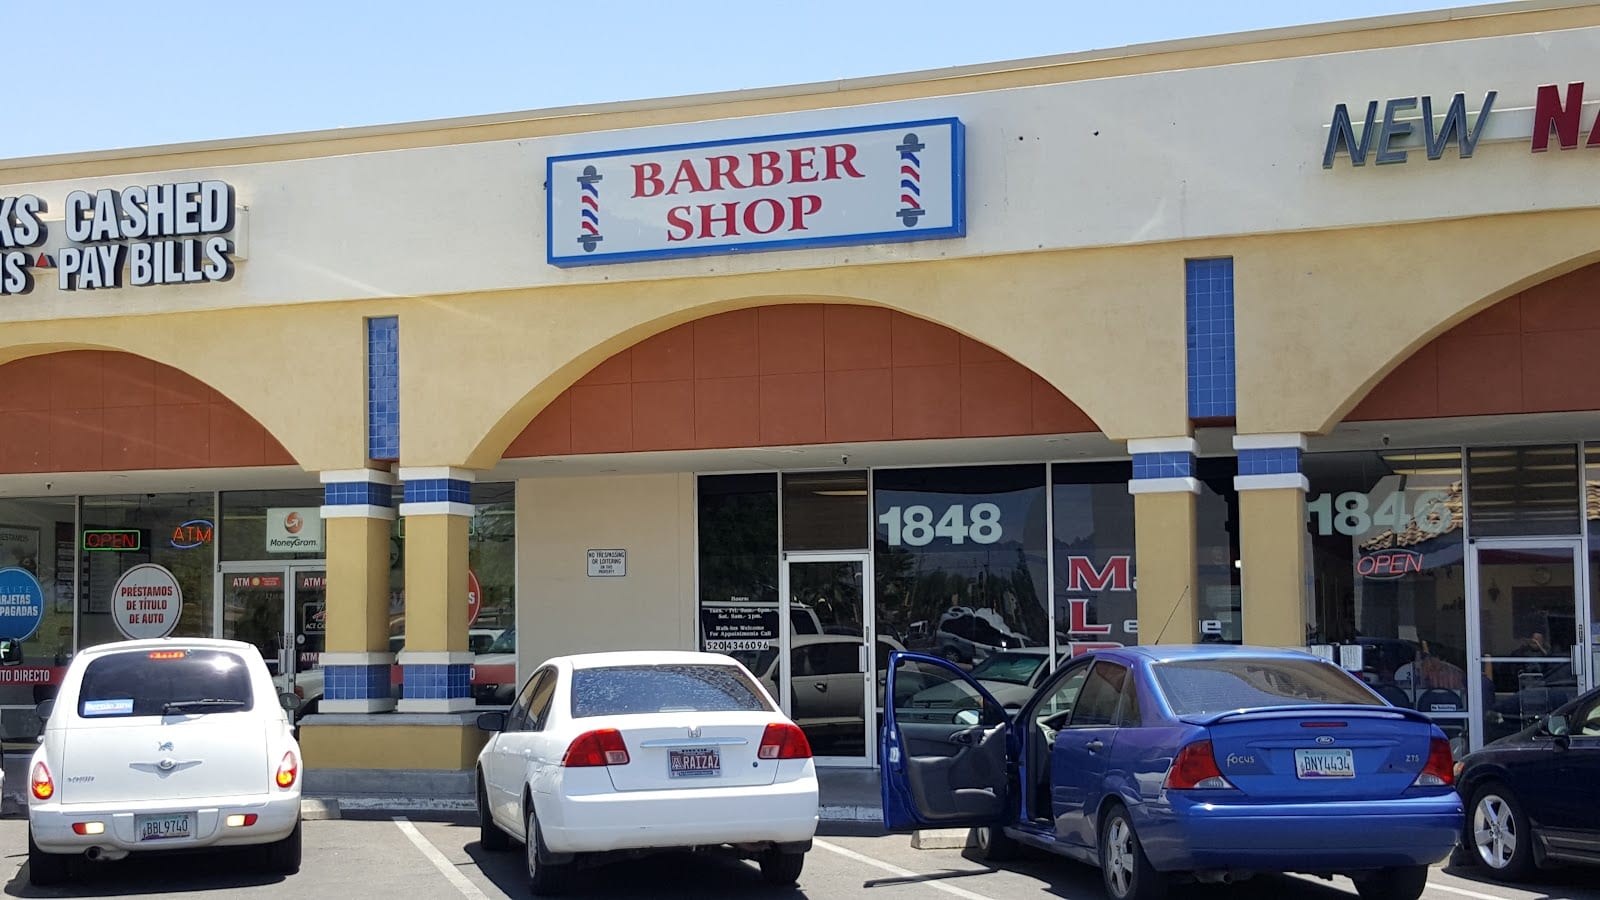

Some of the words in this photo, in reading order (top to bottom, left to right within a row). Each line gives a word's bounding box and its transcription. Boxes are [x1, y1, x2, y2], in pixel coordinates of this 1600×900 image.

[1322, 90, 1498, 169] NEW
[631, 143, 865, 198] BARBER
[65, 180, 234, 243] CASHED
[667, 195, 822, 242] SHOP
[58, 244, 124, 291] PAY
[130, 237, 233, 286] BILLS
[1308, 490, 1451, 537] 1846
[879, 502, 1003, 546] 1848
[87, 533, 135, 548] OPEN
[173, 526, 213, 542] ATM
[270, 538, 317, 548] MoneyGram
[1357, 553, 1423, 576] OPEN
[233, 577, 250, 587] ATM
[303, 577, 320, 588] ATM
[121, 584, 173, 597] PRÉSTAMOS
[126, 600, 137, 611] DE
[139, 597, 167, 610] TÍTULO
[129, 614, 139, 624] DE
[142, 613, 164, 624] AUTO
[301, 652, 317, 662] ATM
[14, 669, 50, 682] DIRECTO
[1304, 756, 1350, 771] BNY4434
[146, 819, 188, 835] BBL9740
